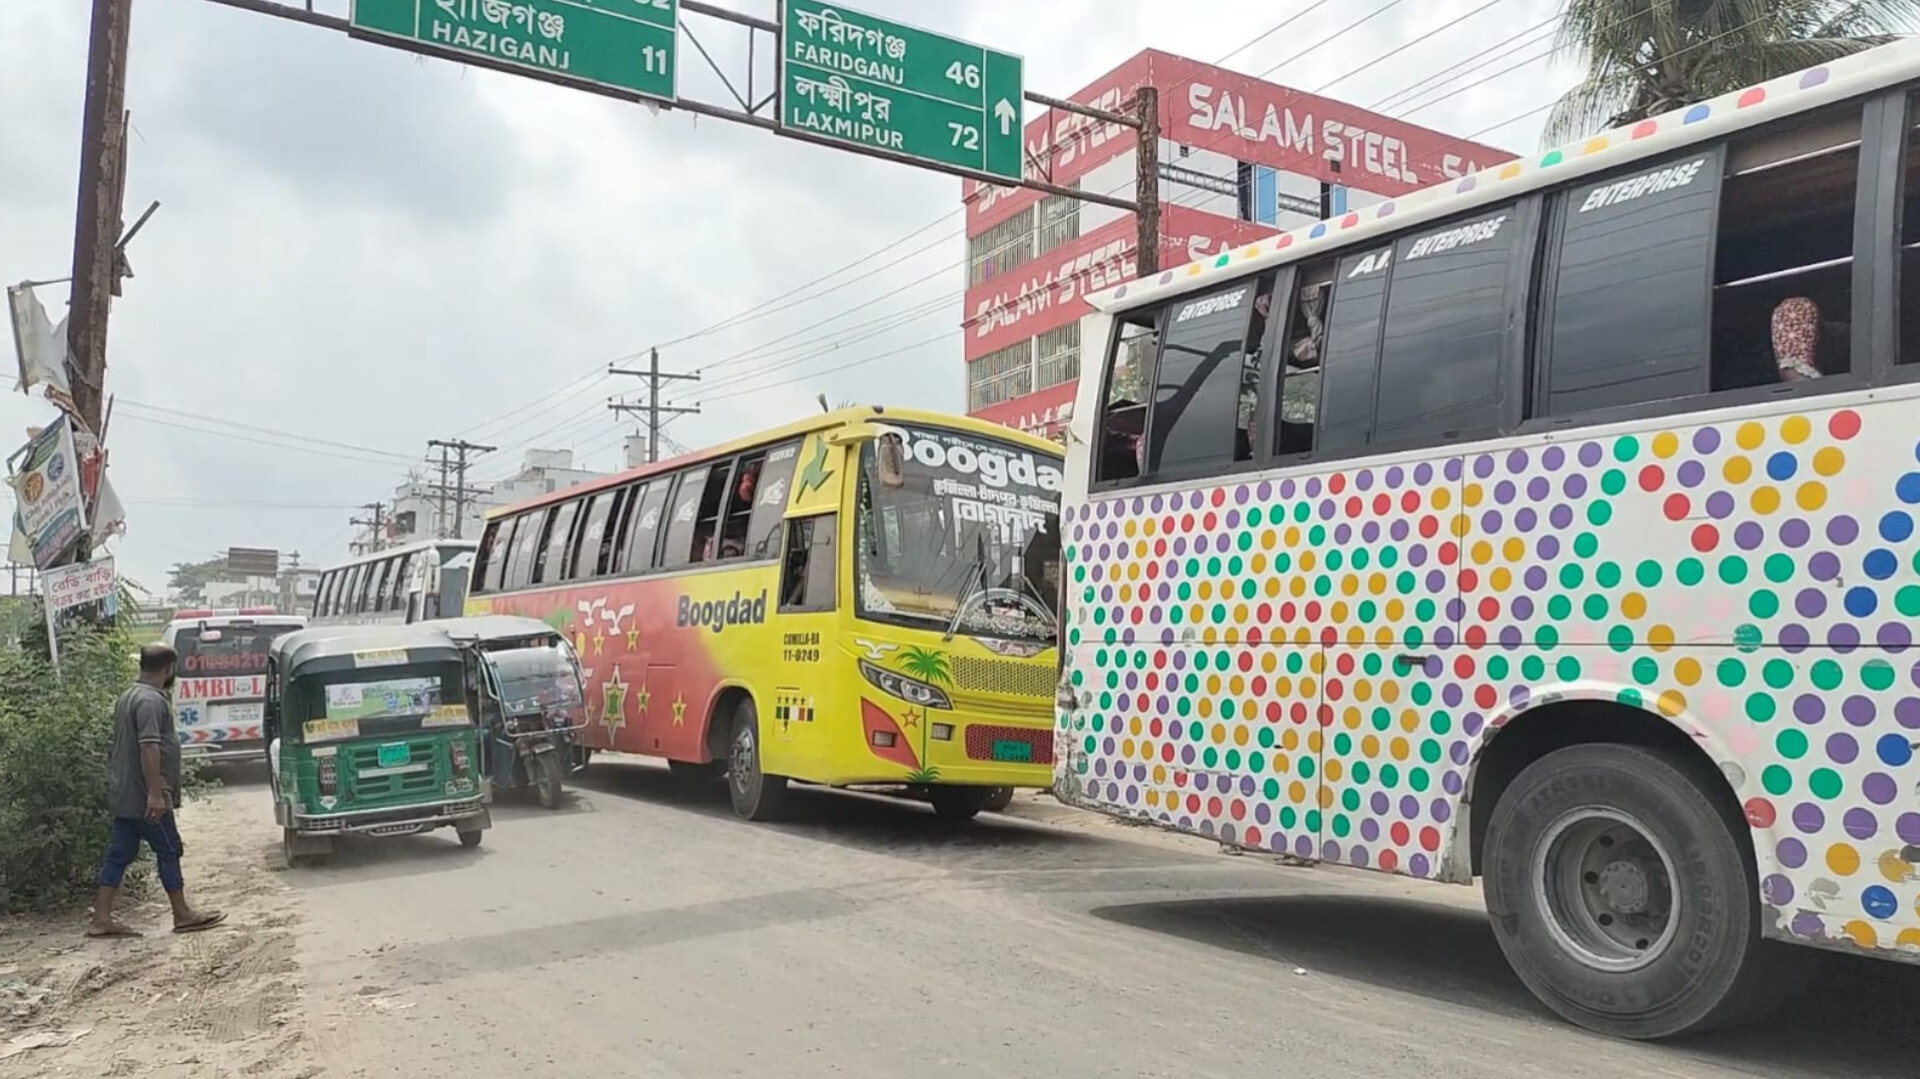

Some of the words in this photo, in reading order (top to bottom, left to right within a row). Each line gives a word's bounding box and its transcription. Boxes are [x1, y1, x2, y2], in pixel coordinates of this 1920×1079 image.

[432, 20, 570, 69] HAZIGANJ
[795, 8, 907, 61] ফরিদগঞ্জ
[642, 46, 667, 75] 11
[795, 41, 904, 84] FARIDGANJ
[945, 61, 980, 89] 46
[793, 75, 892, 123] লক্ষ্মীপুর
[794, 107, 904, 149] LAXMIPUR
[948, 122, 979, 150] 72
[1188, 82, 1314, 156] SALAM
[1323, 118, 1418, 184] STEEL
[1580, 159, 1704, 212] ENTERPRISE
[1405, 215, 1505, 261] ENTERPRISE
[977, 270, 1053, 338] SALAM
[1058, 238, 1137, 305] STEEL
[1177, 288, 1247, 323] ENTERPRISE
[677, 588, 767, 633] Boogdad
[783, 649, 820, 663] 11-0249
